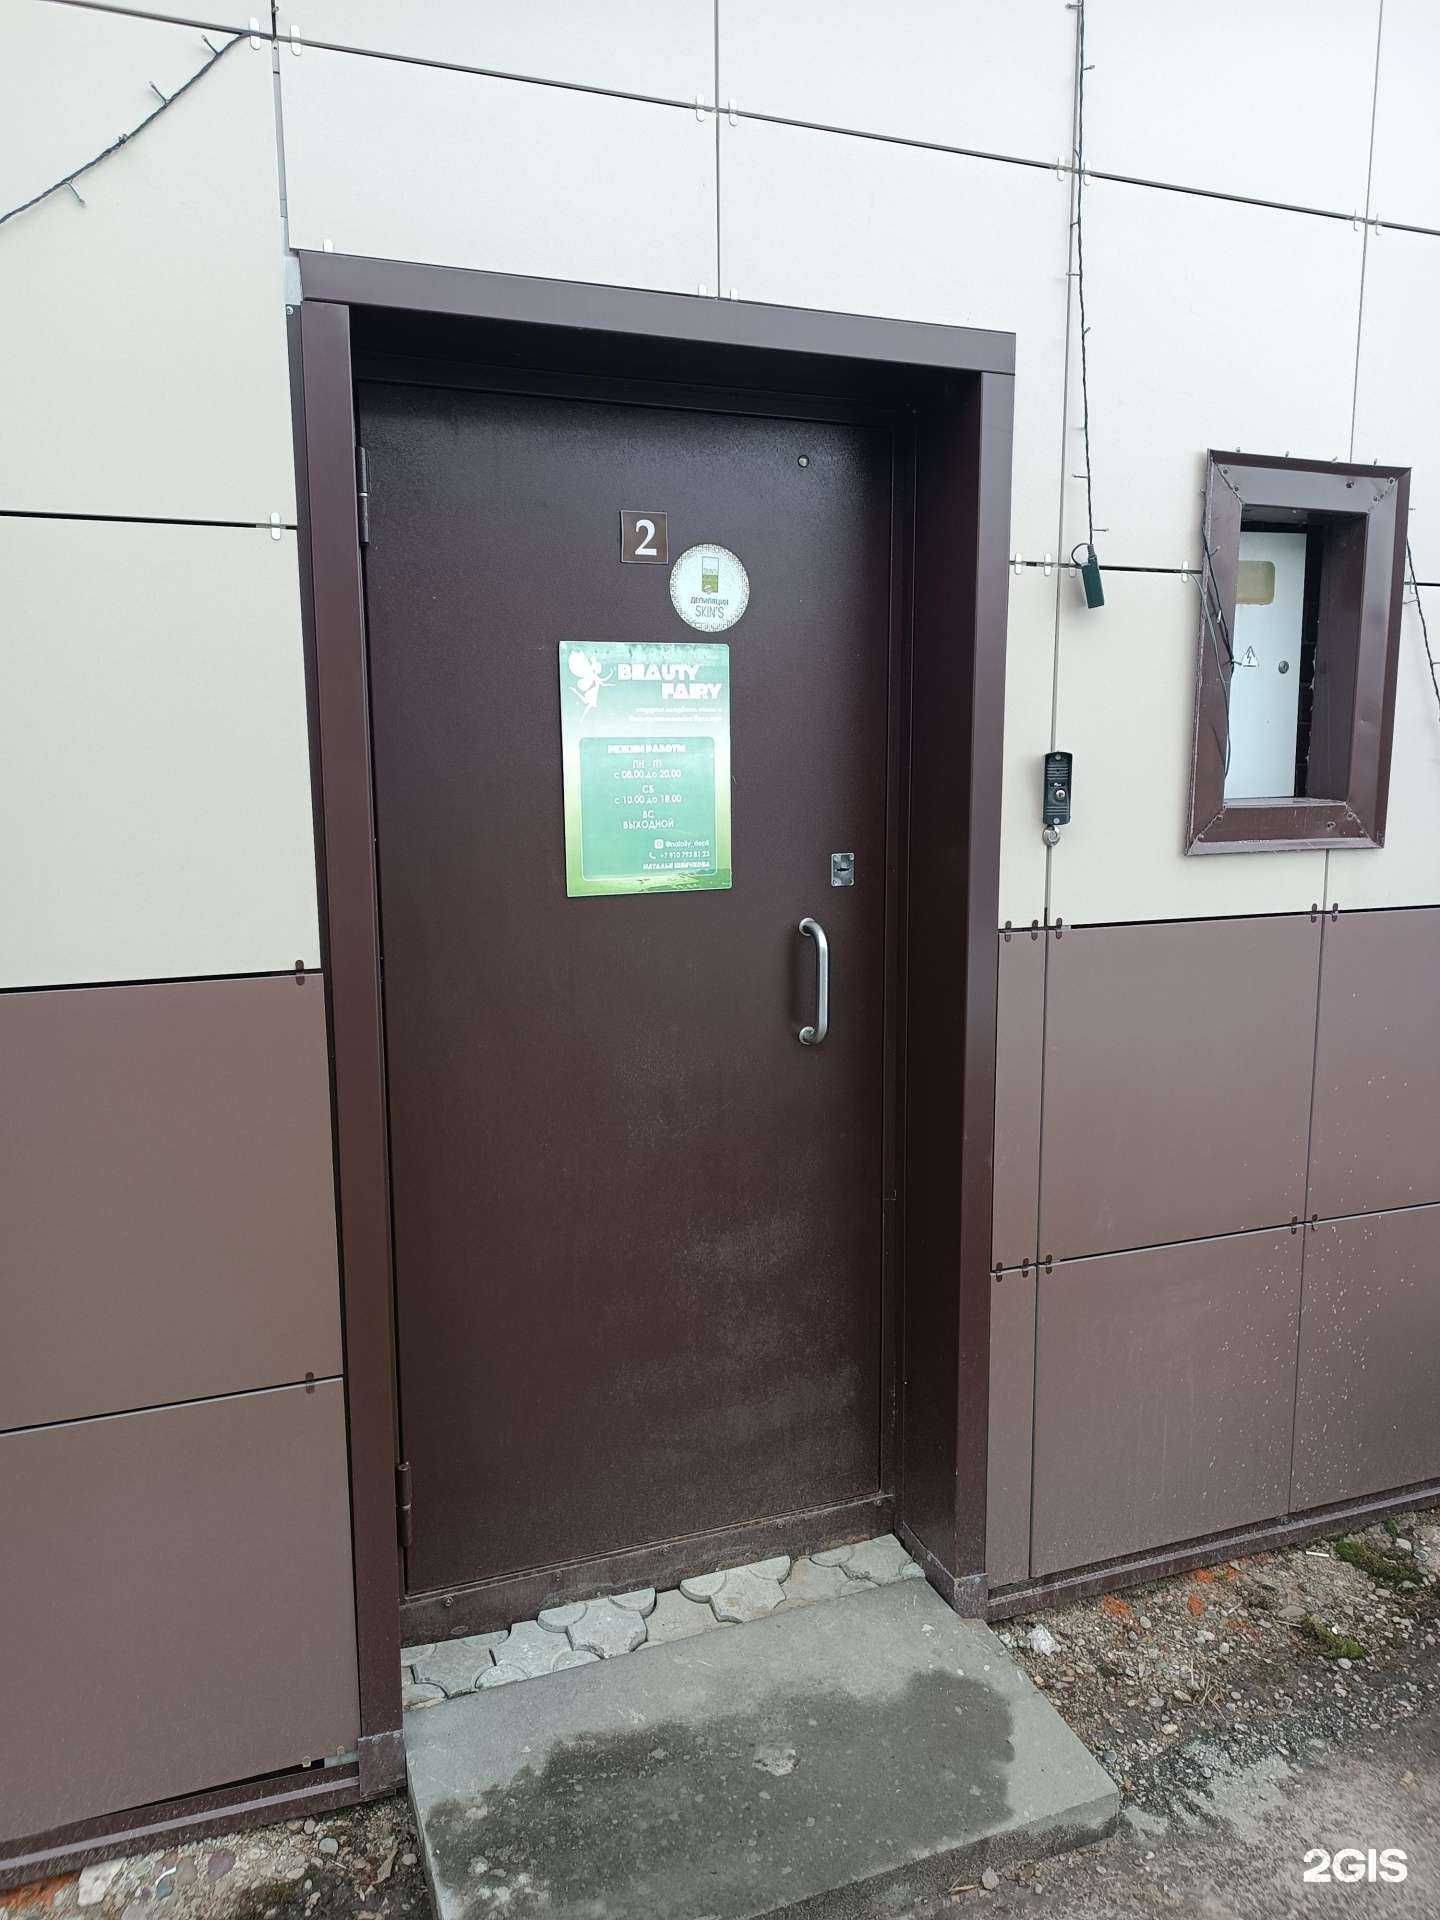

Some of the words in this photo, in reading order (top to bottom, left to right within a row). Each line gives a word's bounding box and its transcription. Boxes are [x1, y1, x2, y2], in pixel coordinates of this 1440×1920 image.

[635, 519, 657, 556] 2
[695, 605, 725, 619] SKIN'S
[617, 663, 702, 681] BEAUTY
[661, 683, 722, 700] FAIRY
[607, 744, 645, 754] РЕЖИМ
[645, 743, 687, 753] РАБОТЫ
[632, 759, 645, 769] ПН
[659, 769, 681, 779] 20.00
[642, 784, 654, 794] СБ
[623, 795, 644, 805] 10.00
[642, 810, 654, 819] ВС
[623, 817, 674, 830] ВЫХОДНОЙ
